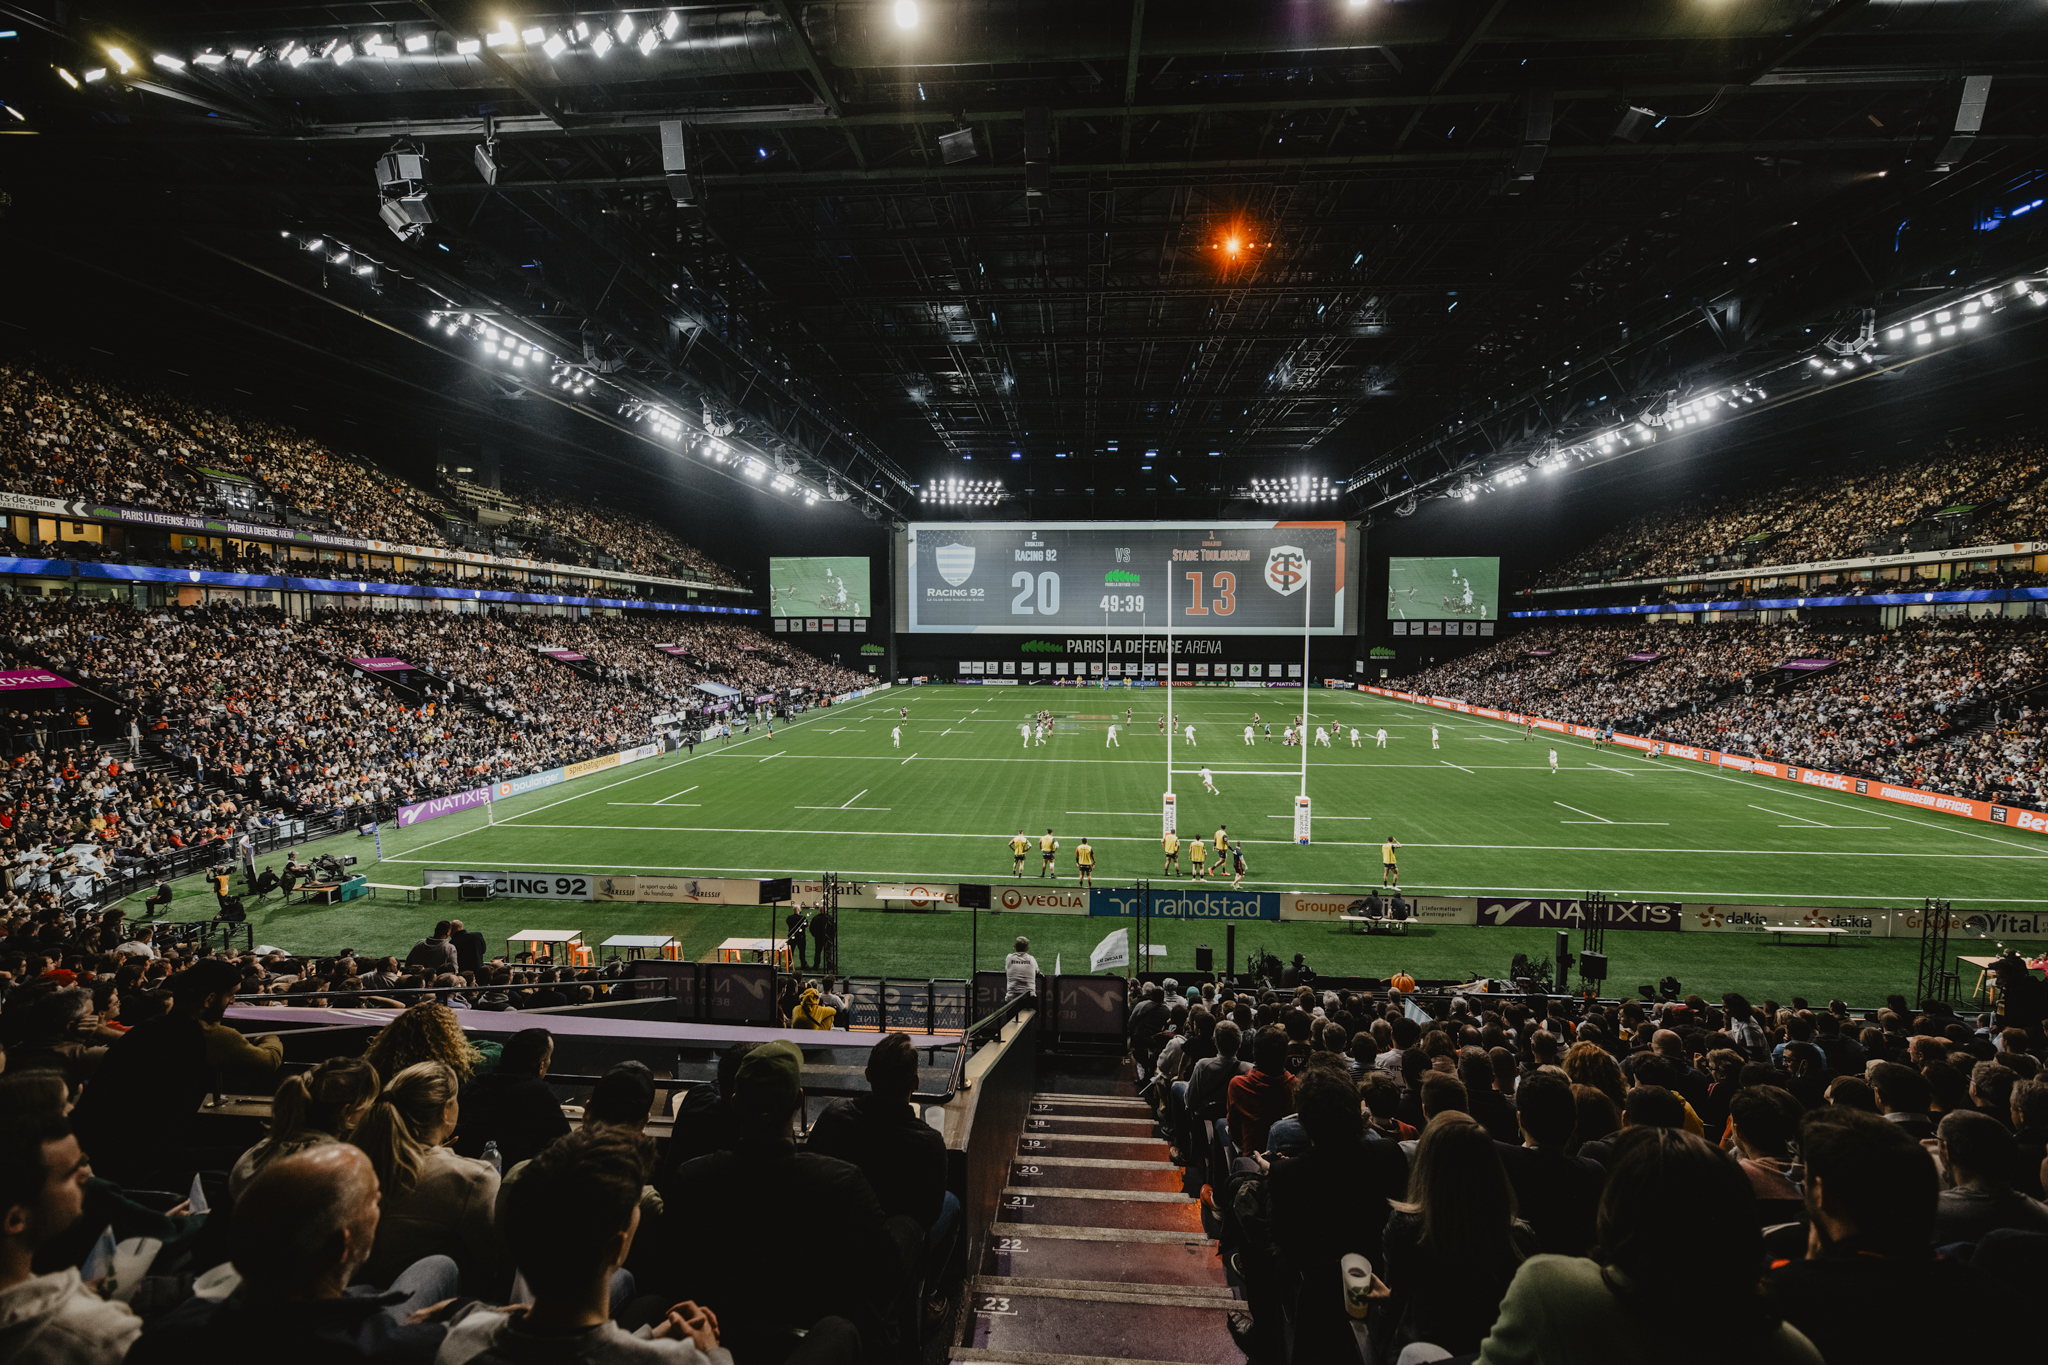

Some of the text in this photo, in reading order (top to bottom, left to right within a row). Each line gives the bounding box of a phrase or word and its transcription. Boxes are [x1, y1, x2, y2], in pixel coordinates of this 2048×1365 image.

[121, 510, 204, 529] PARIS LA DEFENSE ARENA
[227, 524, 295, 539] PARIS LA DEFENSE ARENA
[1032, 532, 1037, 540] 2
[1209, 531, 1214, 539] 1
[313, 534, 327, 543] PARIS
[327, 536, 334, 544] LA
[334, 536, 354, 547] DEFENSE
[387, 544, 412, 554] Doritos
[445, 550, 466, 560] Doritos
[1015, 550, 1057, 561] RACING 92
[1115, 547, 1130, 563] VS
[1173, 549, 1250, 561] STADE TOULOUSAIN
[1951, 549, 1993, 557] CUPRA
[1880, 555, 1915, 563] CUPRA
[927, 588, 985, 597] RACING 92
[1011, 571, 1060, 615] 20
[1185, 571, 1236, 616] 13
[1100, 595, 1144, 613] 49:39
[1066, 639, 1223, 654] PARIS LA DEFENSE ARENA
[1667, 745, 1698, 760] Betclic
[569, 755, 616, 775] spie batignolles
[513, 771, 559, 791] boulanger
[1802, 770, 1848, 790] Betclic
[430, 788, 489, 813] NATIXIS
[1880, 787, 1973, 816] FOURNISSEUR OFFICIEL
[555, 878, 587, 895] 92
[1026, 895, 1083, 908] VEOLIA
[1155, 893, 1261, 917] randstad
[1295, 899, 1345, 915] Groupe
[1726, 912, 1767, 926] dalkia
[1831, 914, 1872, 928] dalkia
[1984, 913, 2040, 936] Vital
[1021, 1165, 1039, 1173] 20
[1012, 1195, 1027, 1205] 21
[999, 1238, 1022, 1250] 22
[983, 1296, 1010, 1311] 23
